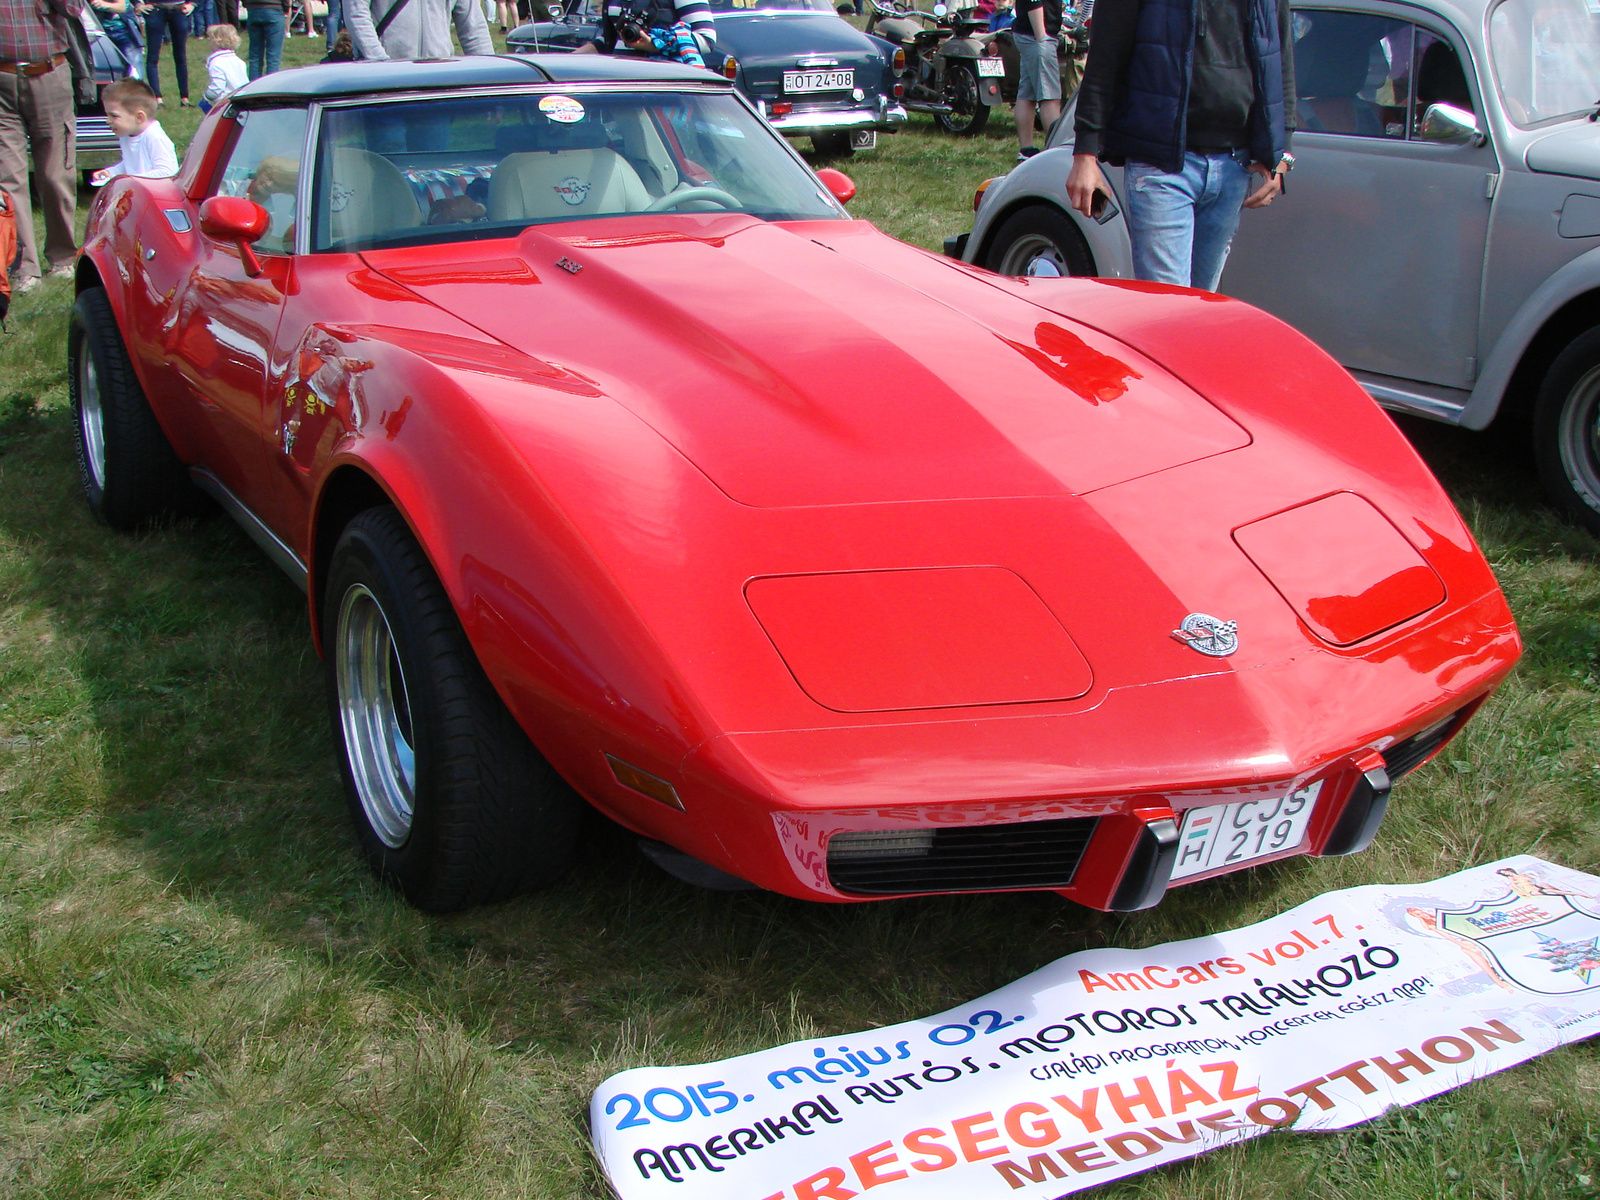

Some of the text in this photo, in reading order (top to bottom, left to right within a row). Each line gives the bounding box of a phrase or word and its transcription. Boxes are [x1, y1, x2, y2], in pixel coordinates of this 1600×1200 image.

[795, 75, 813, 88] OT
[1232, 787, 1309, 829] CJS
[1180, 839, 1206, 866] H
[1225, 819, 1292, 861] 219
[1078, 957, 1245, 993] AmCars
[1030, 1050, 1109, 1081] CSALÁDI
[1236, 1011, 1346, 1046] KONCERTEK
[1337, 993, 1395, 1014] EGÉSZ
[1391, 975, 1431, 999] NAP!
[606, 1010, 1026, 1130] 2015. május 02.
[633, 1095, 844, 1184] AMERIKAI
[999, 1004, 1198, 1060] MOTOROS
[1199, 939, 1400, 1021] TALÁLKOZÓ
[763, 1059, 1261, 1200] RESEGYHÁZ
